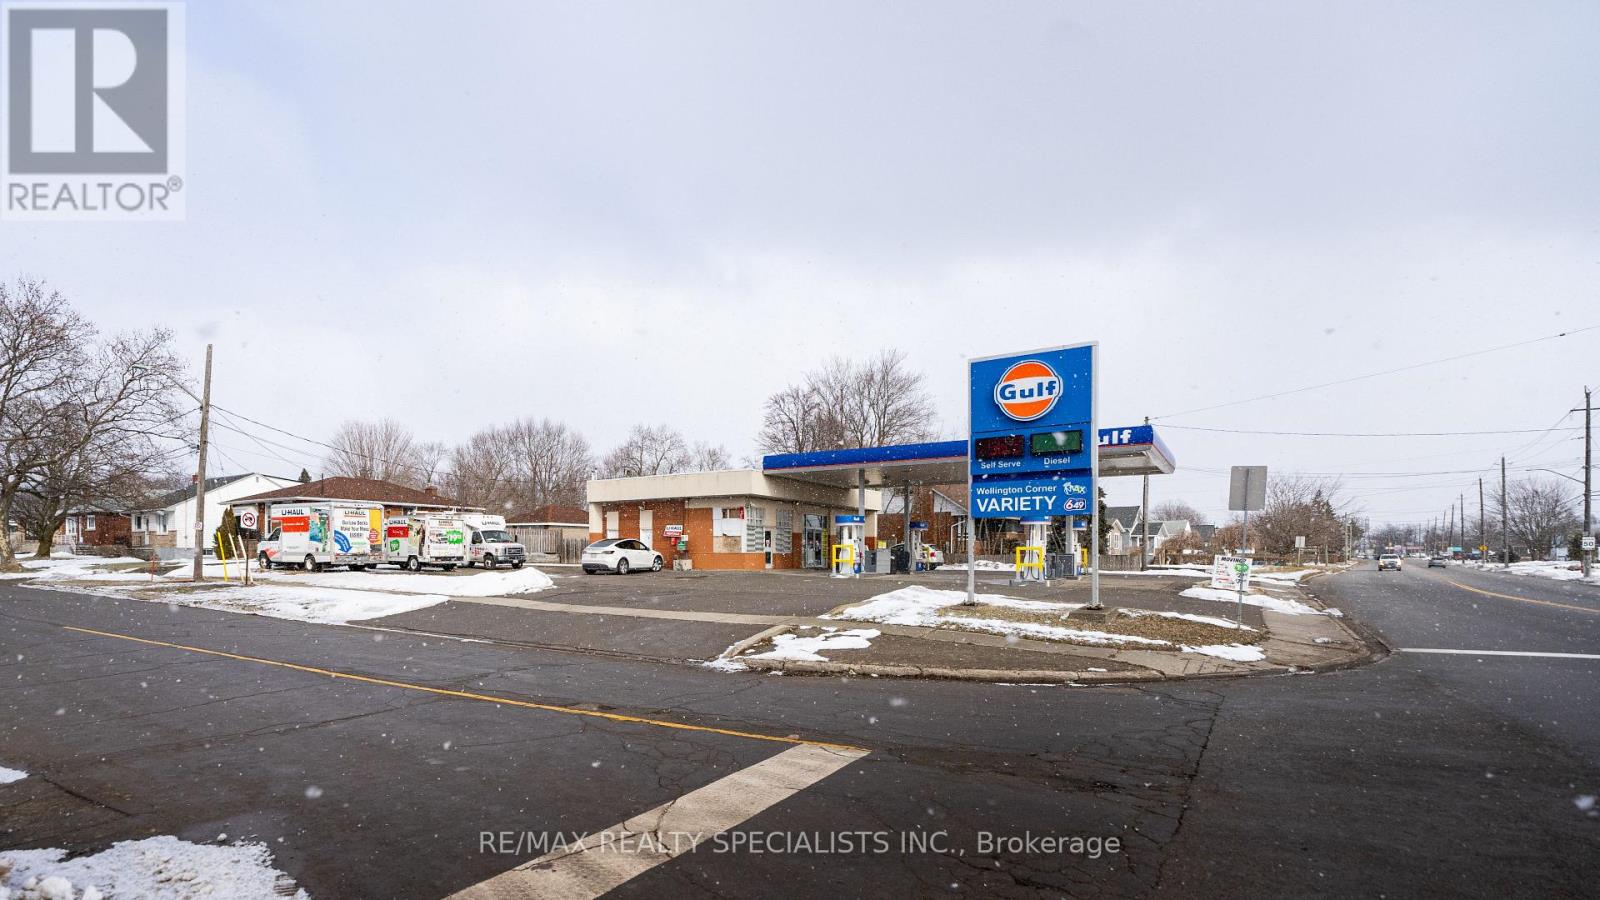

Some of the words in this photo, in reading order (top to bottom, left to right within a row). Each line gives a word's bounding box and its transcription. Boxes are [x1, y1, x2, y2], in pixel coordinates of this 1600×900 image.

[999, 380, 1056, 400] Gulf
[1098, 429, 1132, 446] ulf
[980, 461, 996, 469] Self
[998, 460, 1021, 468] Serve
[1043, 456, 1071, 465] Diesel
[976, 485, 1023, 496] Wellington
[1025, 484, 1058, 493] Corner
[976, 495, 1057, 513] VARIETY
